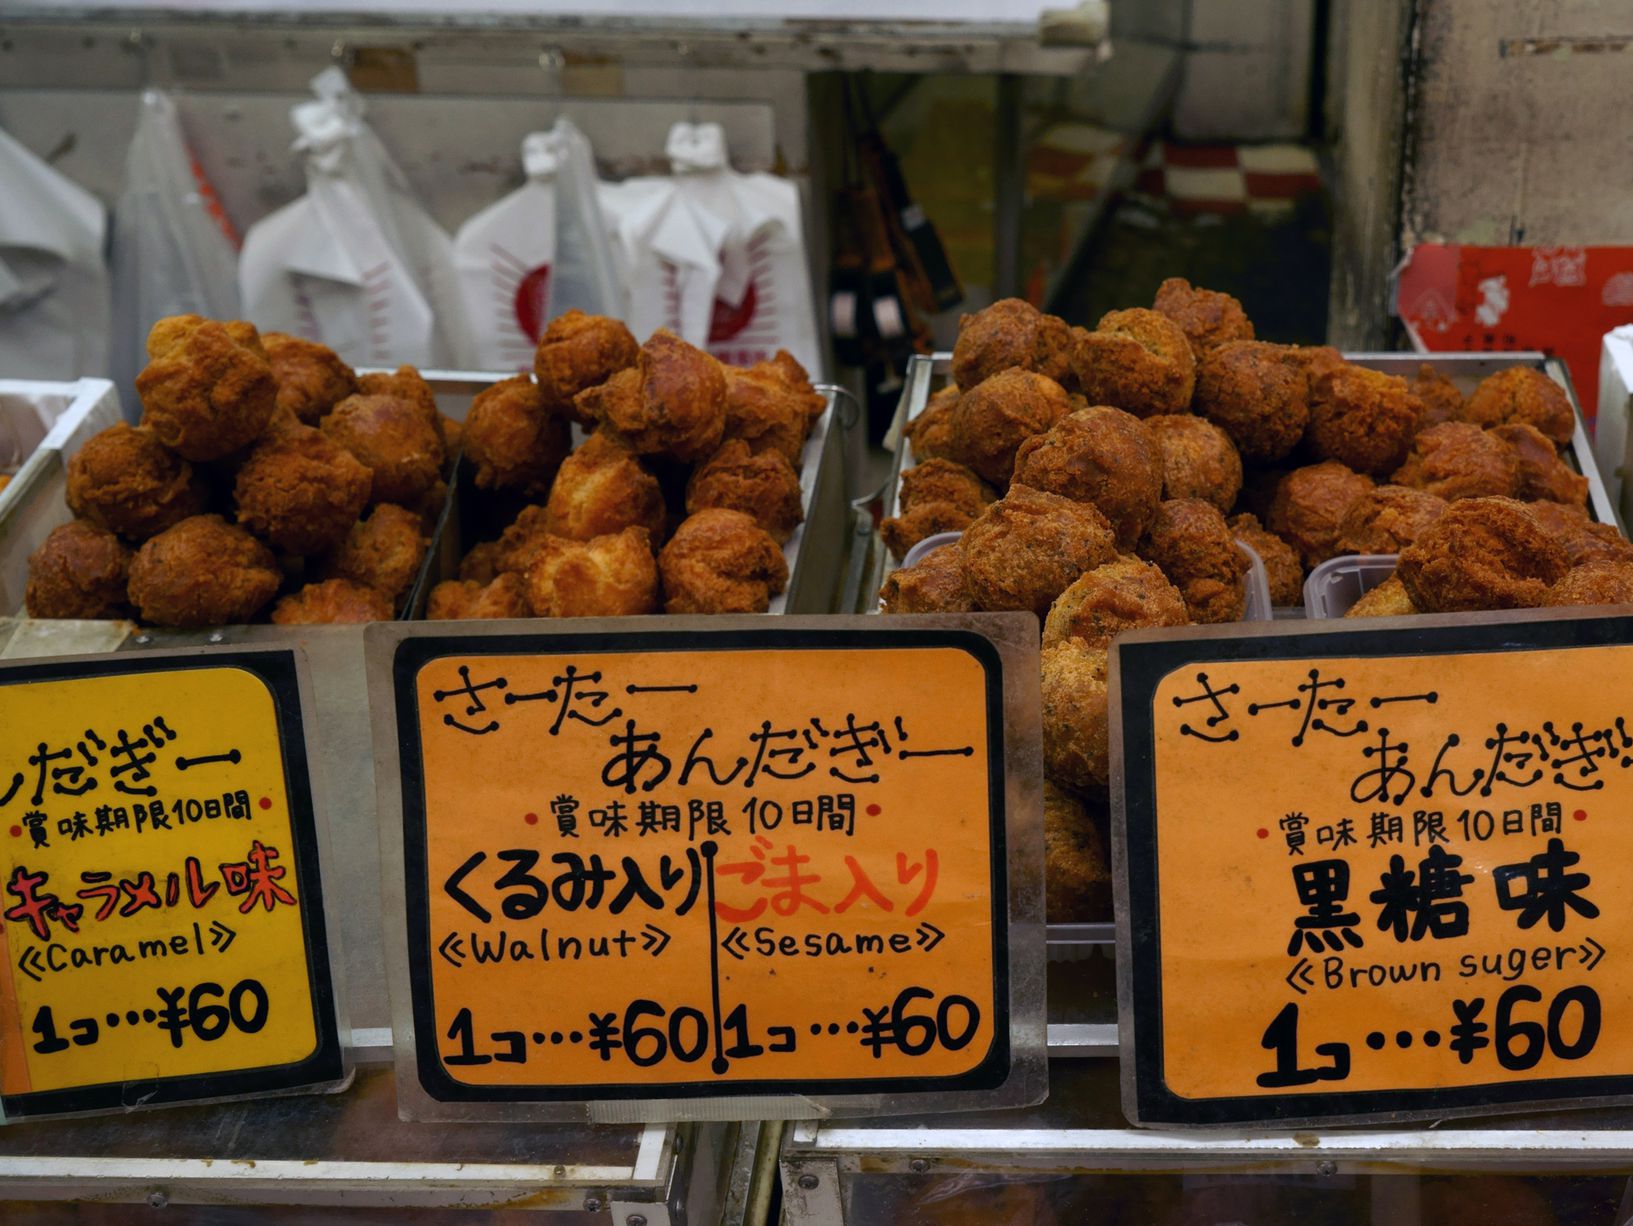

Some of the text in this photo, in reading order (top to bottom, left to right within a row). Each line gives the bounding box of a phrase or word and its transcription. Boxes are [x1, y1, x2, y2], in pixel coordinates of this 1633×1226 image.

[433, 665, 698, 736] さーたー
[1172, 668, 1439, 748] さーたー
[601, 714, 974, 795] あんだぎー
[1350, 716, 1633, 806] あんだぎ
[21, 789, 253, 850] 賞味期限10日間
[550, 794, 856, 841] 賞味期限10日間
[1279, 801, 1562, 856] 賞味期限10日間
[3, 839, 298, 942] キャラメル味
[443, 846, 702, 924] くるみ入り
[714, 836, 939, 923] ごま入り
[1286, 837, 1601, 957] 黒糖味
